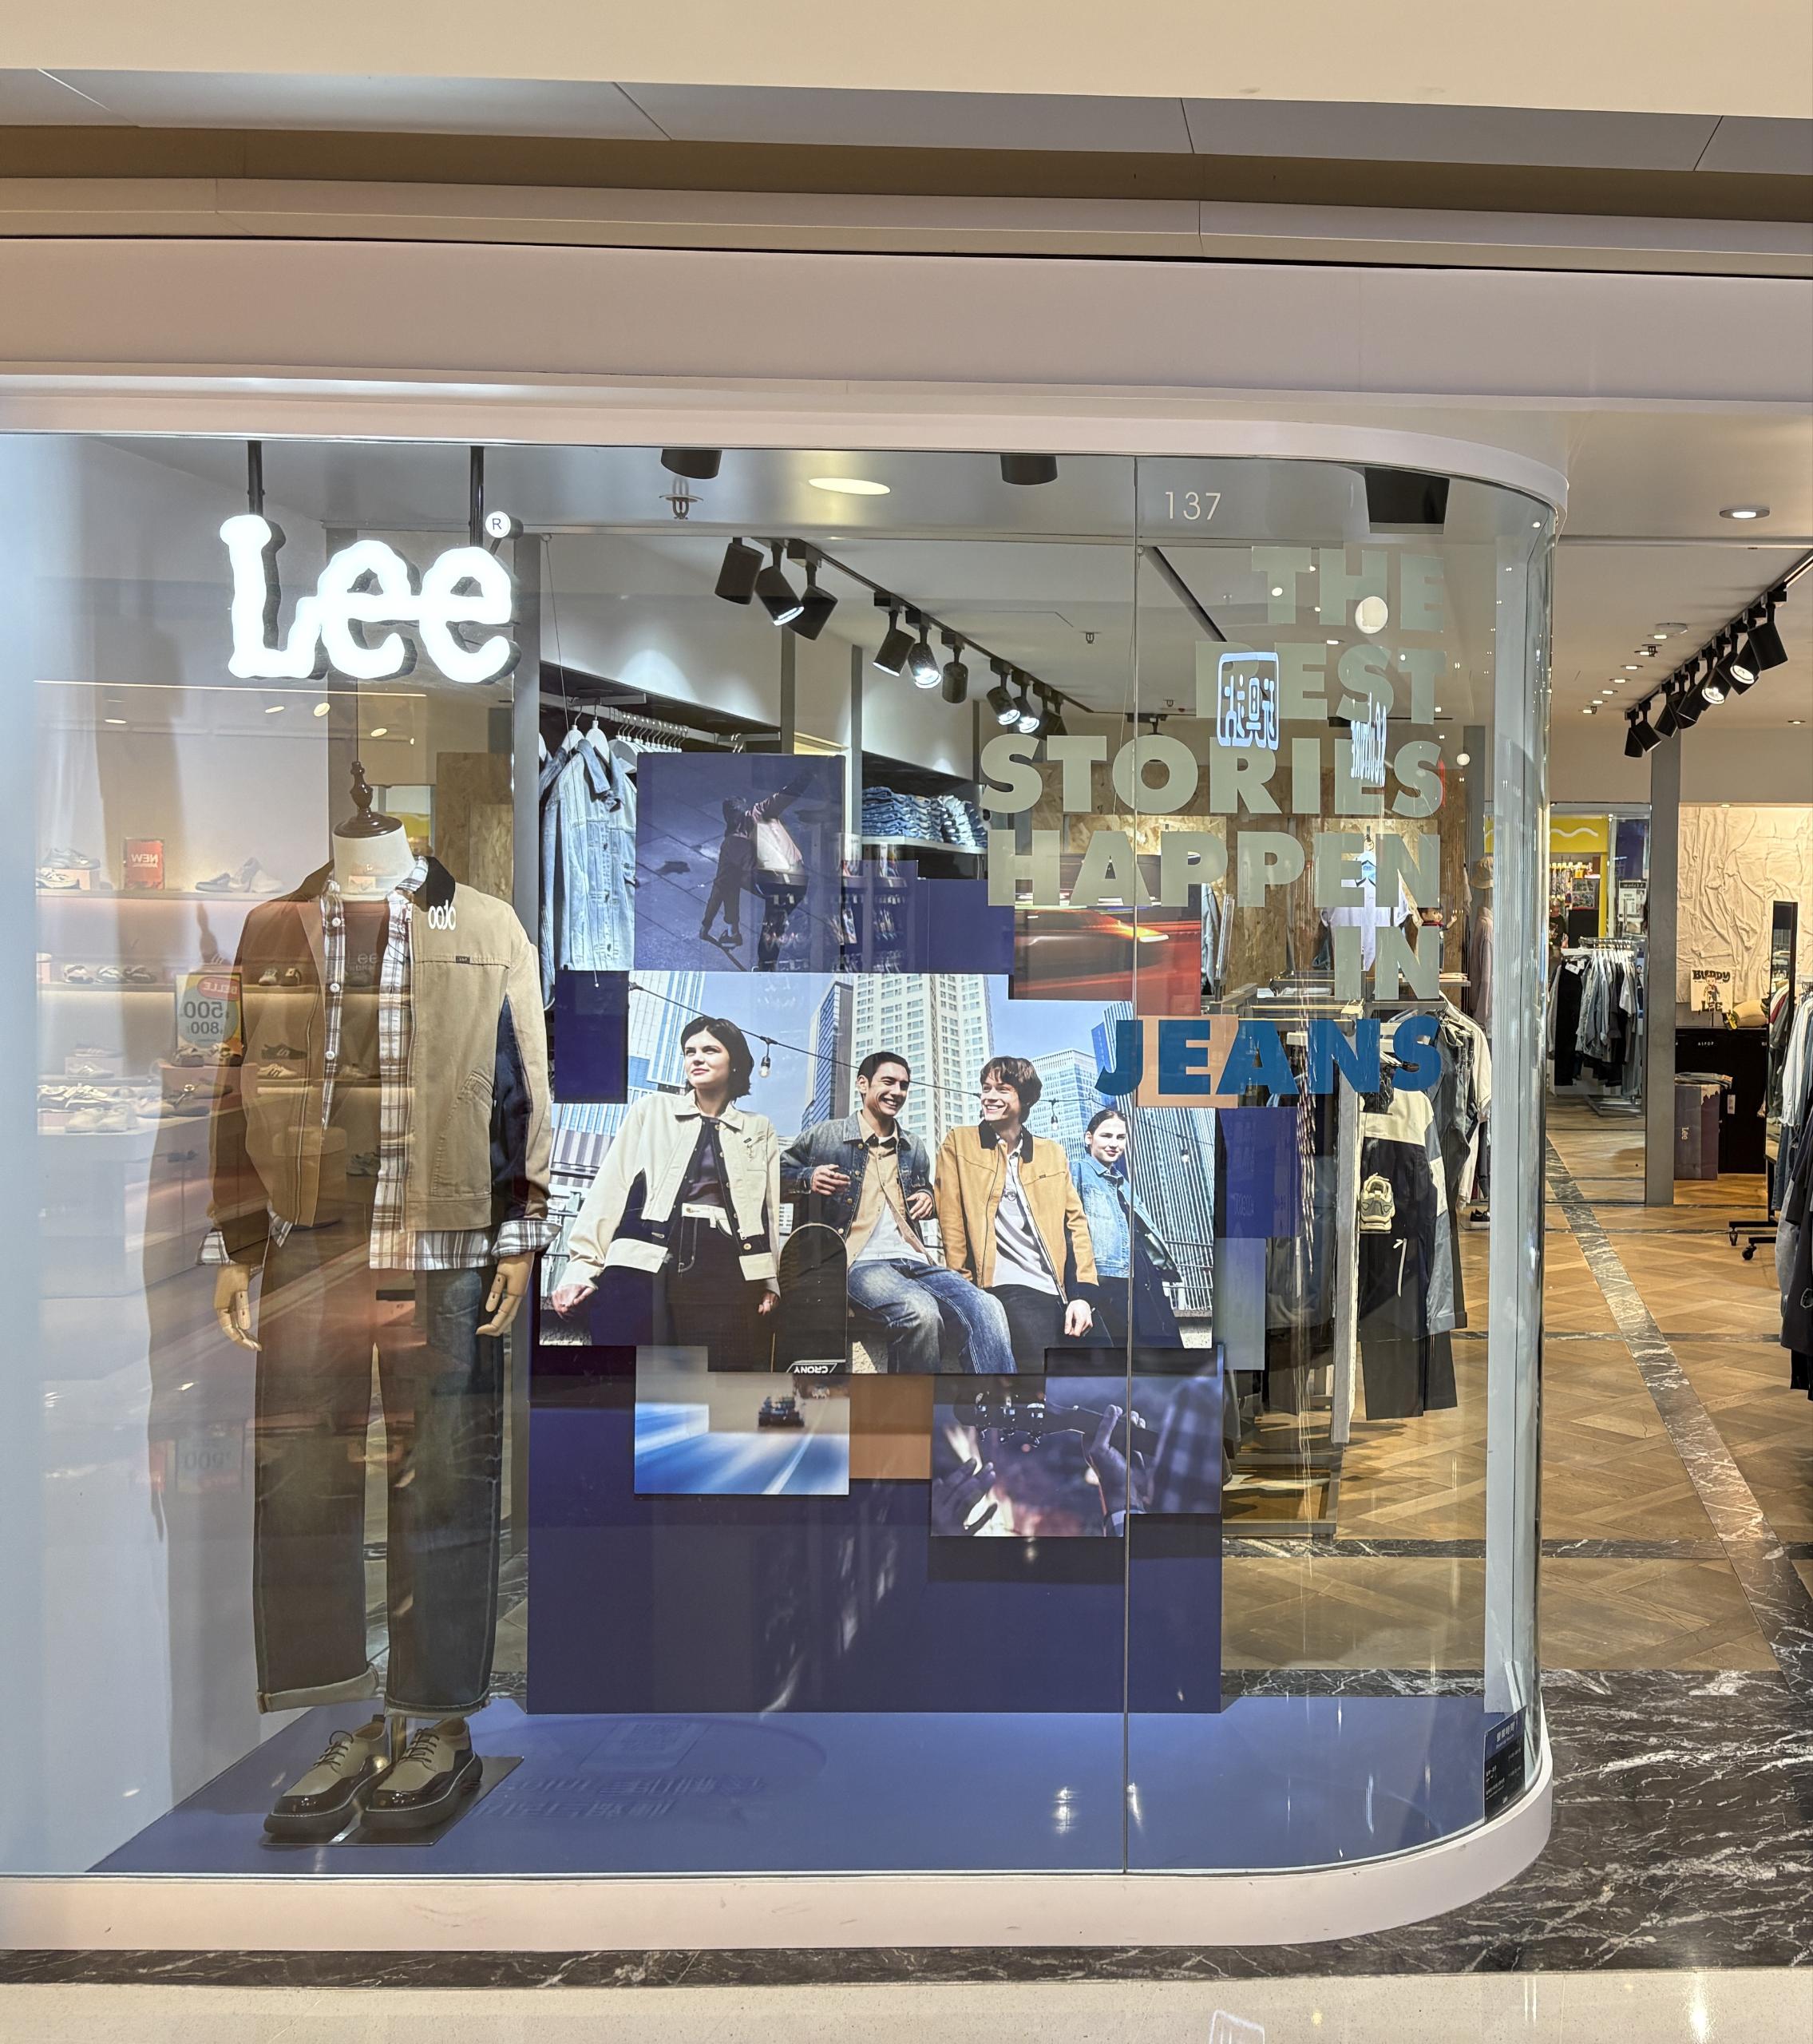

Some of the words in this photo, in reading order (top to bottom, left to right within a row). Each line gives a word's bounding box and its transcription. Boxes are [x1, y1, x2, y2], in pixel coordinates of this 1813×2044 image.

[1164, 491, 1221, 521] 137
[220, 513, 515, 683] Lee
[1252, 546, 1444, 632] THE
[979, 734, 1443, 818] STORIES
[988, 830, 1441, 908] HAPPEN
[1334, 925, 1441, 1001] IN
[1095, 1015, 1442, 1096] JEANS
[1681, 1127, 1690, 1141] Lee
[793, 1365, 829, 1374] CRONY
